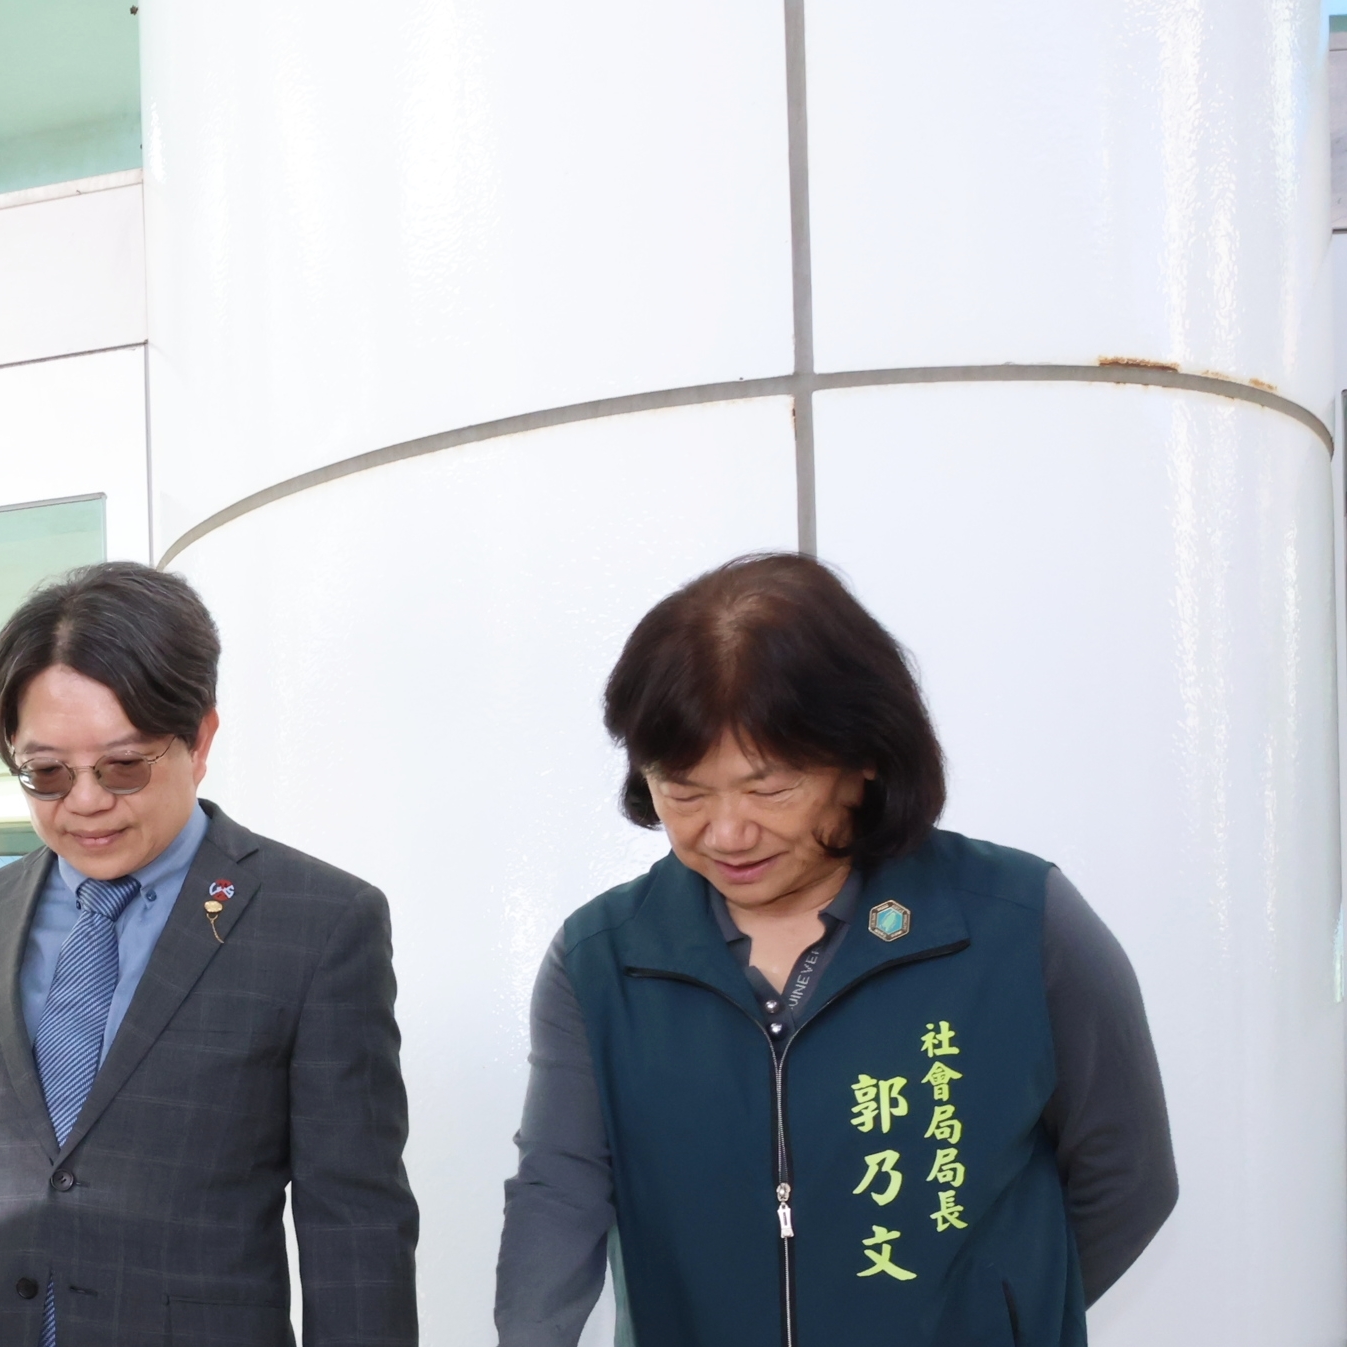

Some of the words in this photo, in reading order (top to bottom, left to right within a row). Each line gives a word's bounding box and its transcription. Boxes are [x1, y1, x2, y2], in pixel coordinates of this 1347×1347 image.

[850, 1073, 918, 1282] 郭乃文
[919, 1020, 969, 1233] 社會局局長
